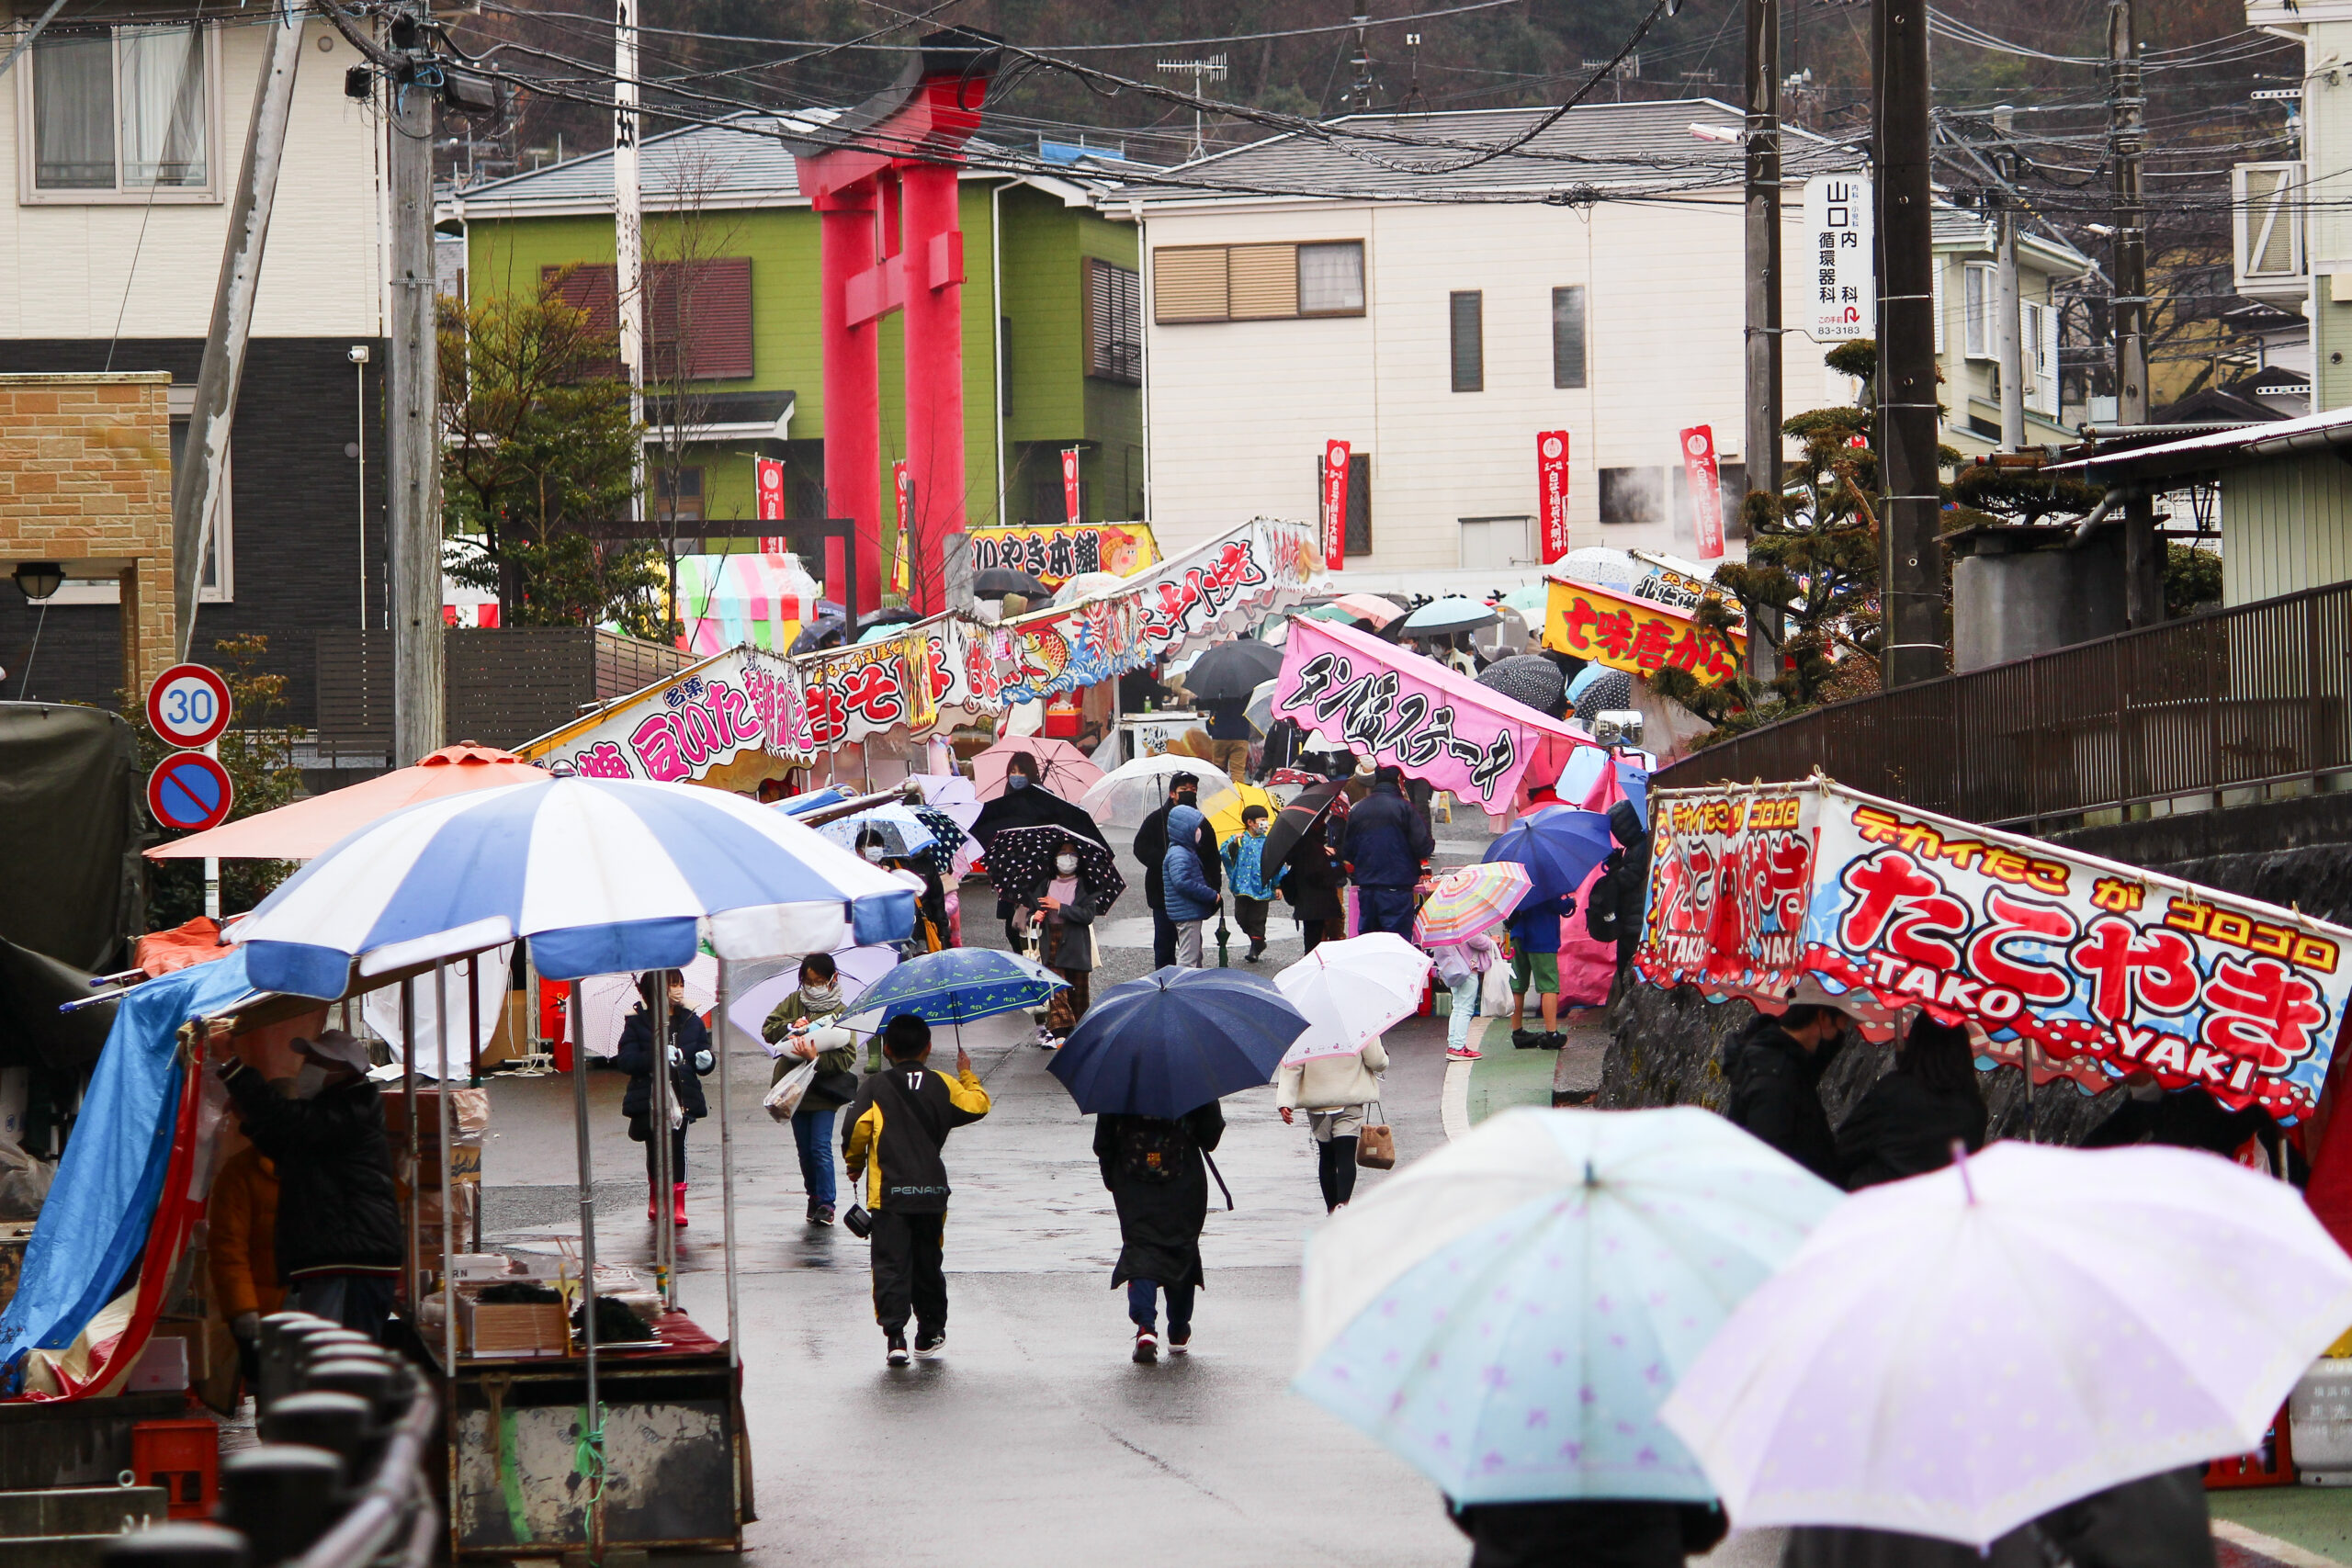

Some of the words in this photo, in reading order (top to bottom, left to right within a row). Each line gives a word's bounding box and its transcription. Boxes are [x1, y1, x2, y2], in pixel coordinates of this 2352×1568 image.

[1827, 181, 1849, 227] 山口
[1818, 231, 1836, 303] 循環器科
[1817, 326, 1860, 334] 83-3183
[1818, 316, 1843, 324] この手前
[1562, 596, 1736, 689] 七味唐がら
[167, 689, 212, 724] 30
[663, 674, 706, 710] 名菓
[1747, 795, 1800, 830] ゴロゴロ
[1851, 805, 2070, 897] デカイたこ
[2089, 875, 2145, 912] が
[2163, 896, 2340, 974] ゴロゴロ
[1837, 845, 2332, 1077] たこやき
[1867, 947, 2027, 1023] TAKO
[2113, 1020, 2260, 1095] YAKI
[907, 1071, 923, 1090] 17
[890, 1186, 948, 1195] PENALTY
